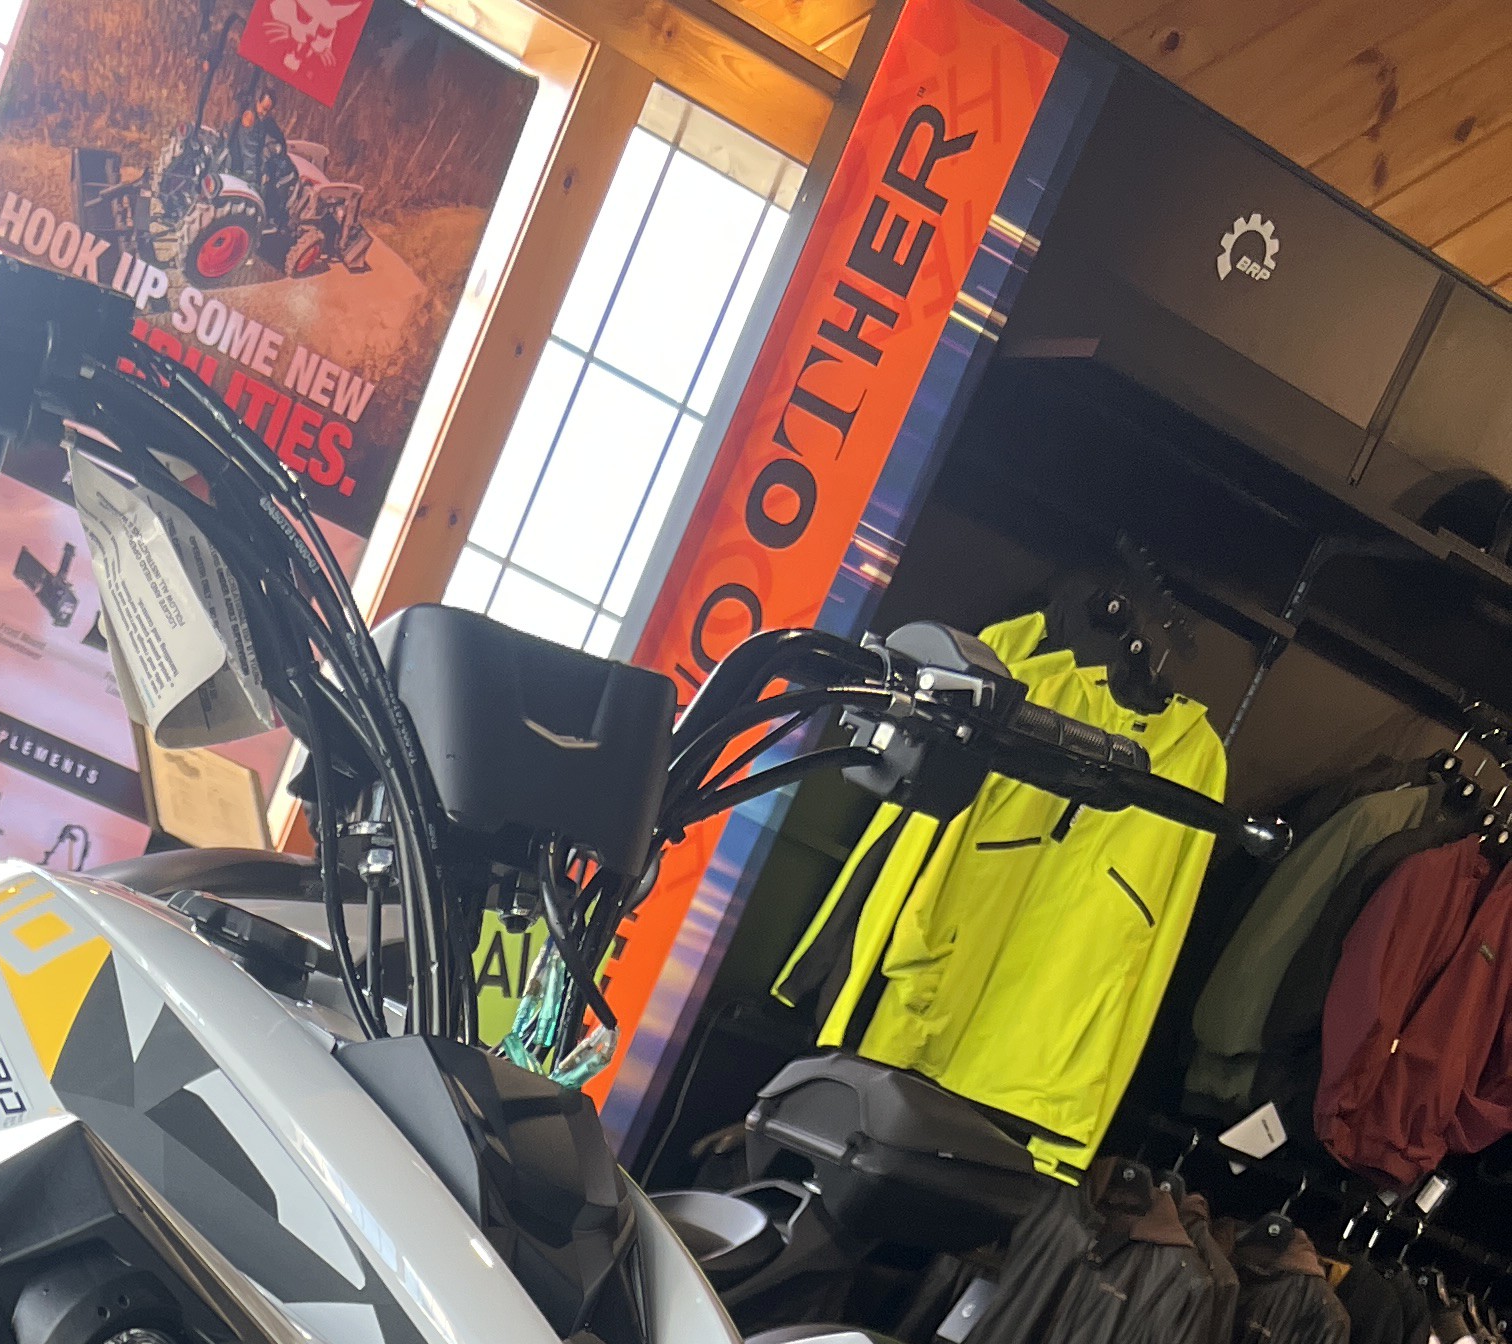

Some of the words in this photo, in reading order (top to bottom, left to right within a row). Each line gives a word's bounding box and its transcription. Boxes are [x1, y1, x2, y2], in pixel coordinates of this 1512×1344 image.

[1236, 256, 1271, 280] BRP
[111, 251, 168, 310] UP
[171, 286, 284, 378] SOME
[284, 344, 376, 424] NEW
[149, 580, 163, 598] AND
[157, 579, 170, 594] ALL
[158, 598, 178, 629] LOCATE
[165, 594, 186, 626] FOLLOW
